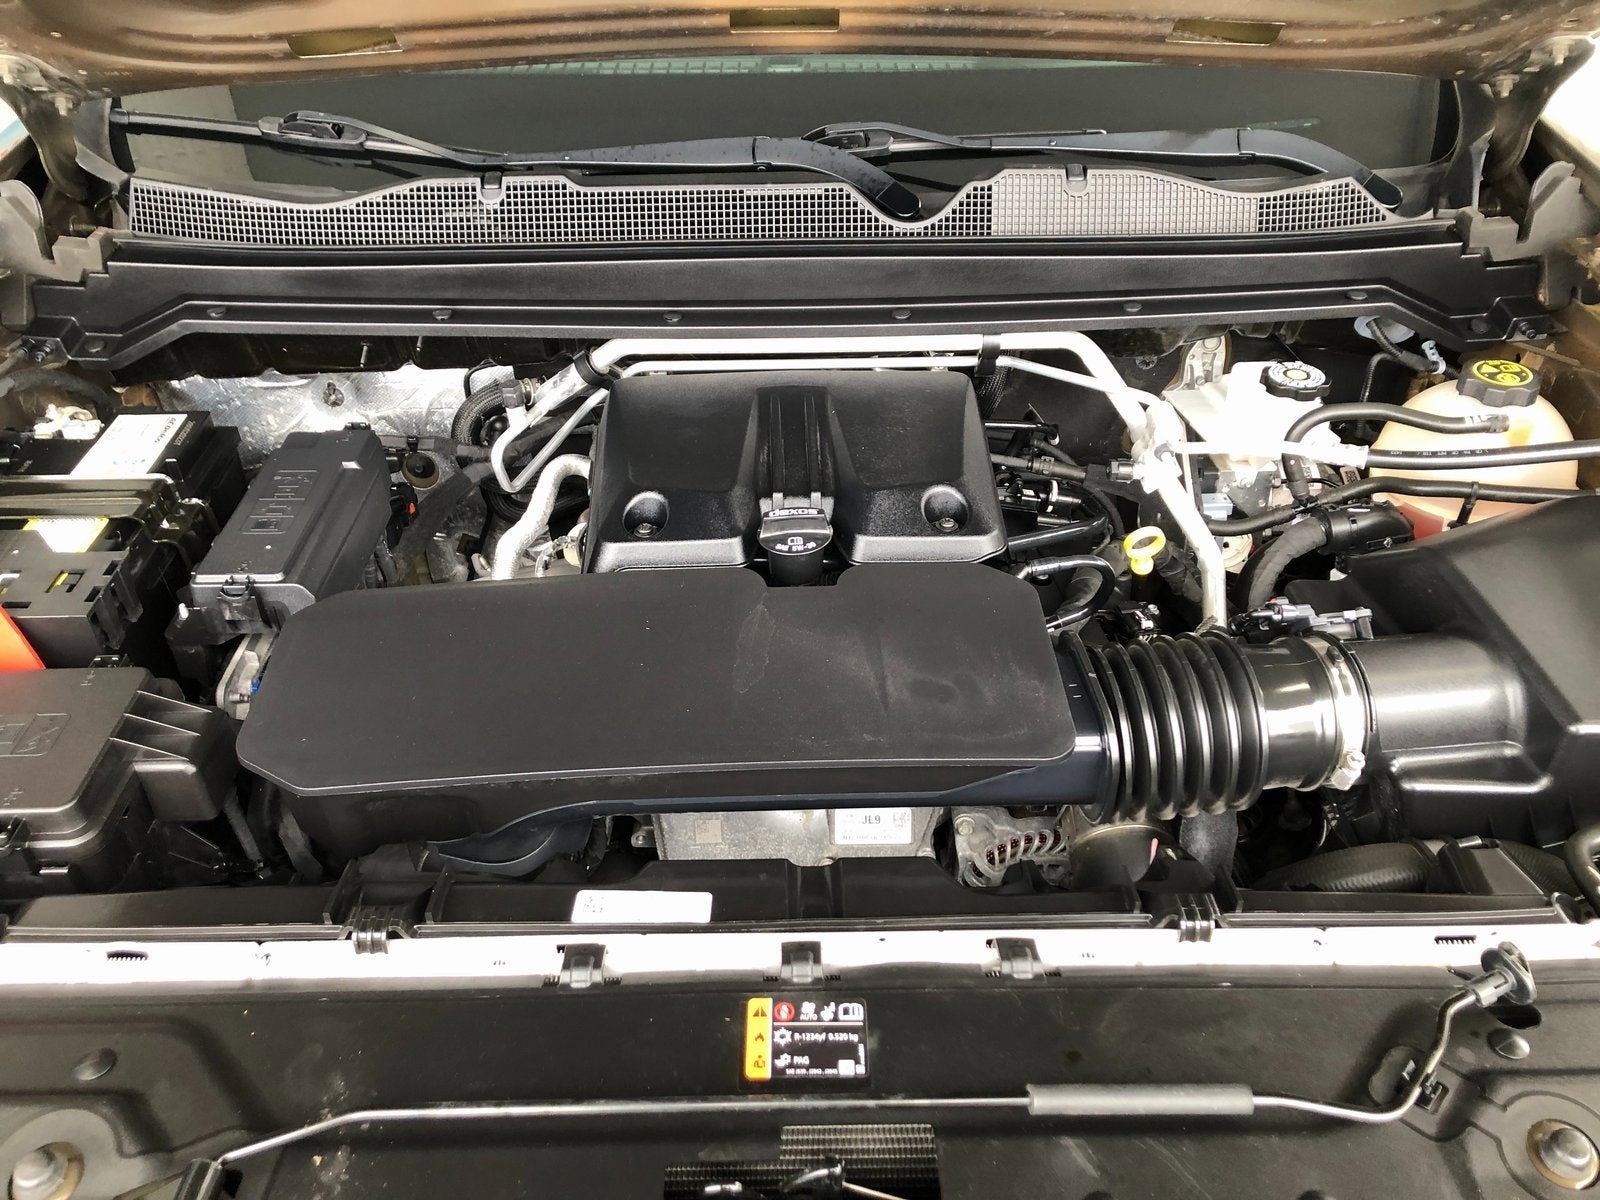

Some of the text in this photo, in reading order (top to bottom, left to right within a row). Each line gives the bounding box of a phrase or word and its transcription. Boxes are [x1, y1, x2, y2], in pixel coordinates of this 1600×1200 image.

[768, 508, 818, 517] dexos
[775, 543, 789, 551] SAE
[862, 814, 881, 824] JL9
[794, 1032, 859, 1042] R-1234yf 0.520 kg
[793, 1056, 810, 1065] PAG
